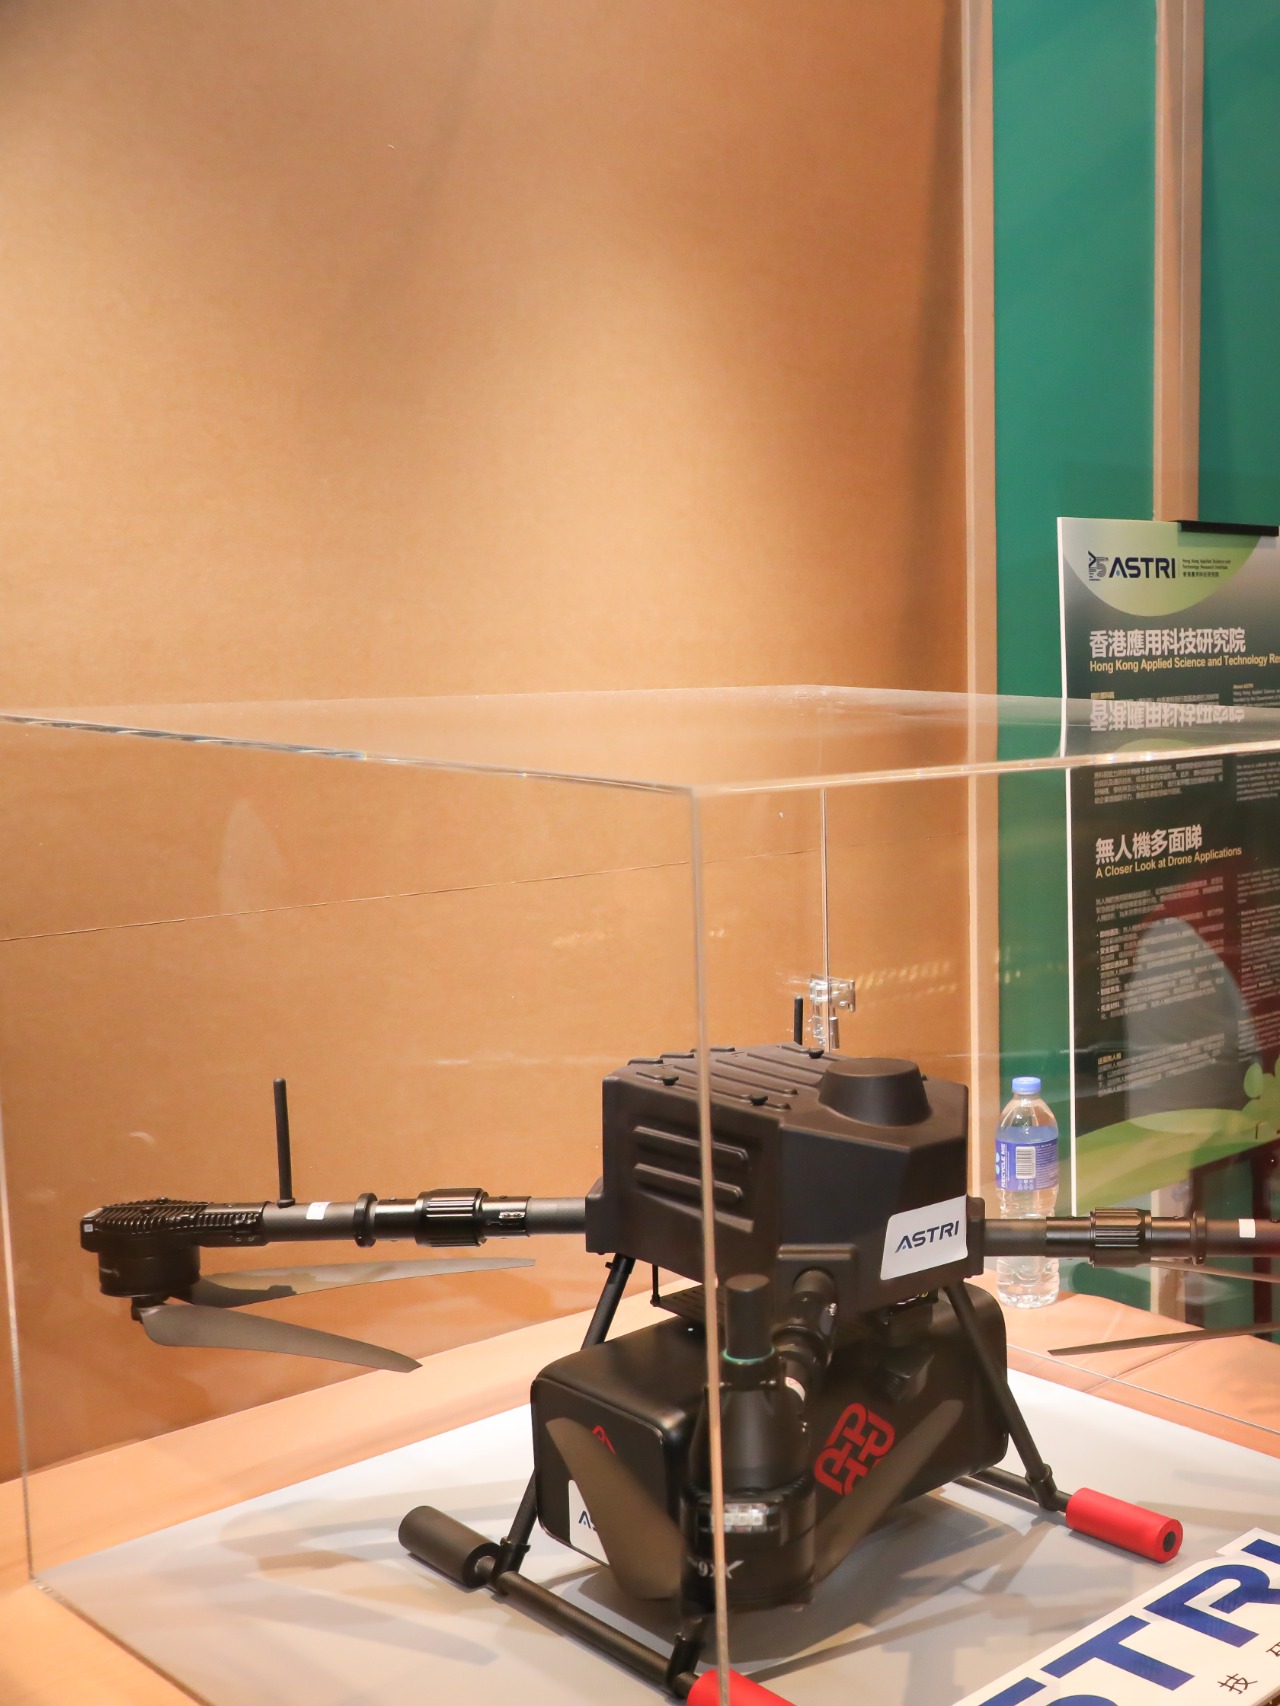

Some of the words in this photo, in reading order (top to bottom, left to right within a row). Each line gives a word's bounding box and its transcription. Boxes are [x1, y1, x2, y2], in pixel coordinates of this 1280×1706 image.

[1109, 557, 1176, 579] ASTRI
[1089, 628, 1246, 658] 香港應用科技研究院
[1090, 661, 1113, 673] Hong
[1116, 660, 1139, 672] Kong
[1141, 658, 1172, 671] Applied
[1174, 657, 1205, 668] Science
[1208, 656, 1222, 666] and
[1224, 655, 1267, 666] Technology
[1095, 824, 1202, 865] 無人機多面睇
[1096, 867, 1103, 879] A
[1105, 864, 1132, 877] Closer
[1135, 859, 1156, 872] Look
[1158, 858, 1166, 868] at
[1168, 854, 1192, 867] Drone
[1194, 846, 1242, 864] Applications
[895, 1220, 959, 1253] ASTRI
